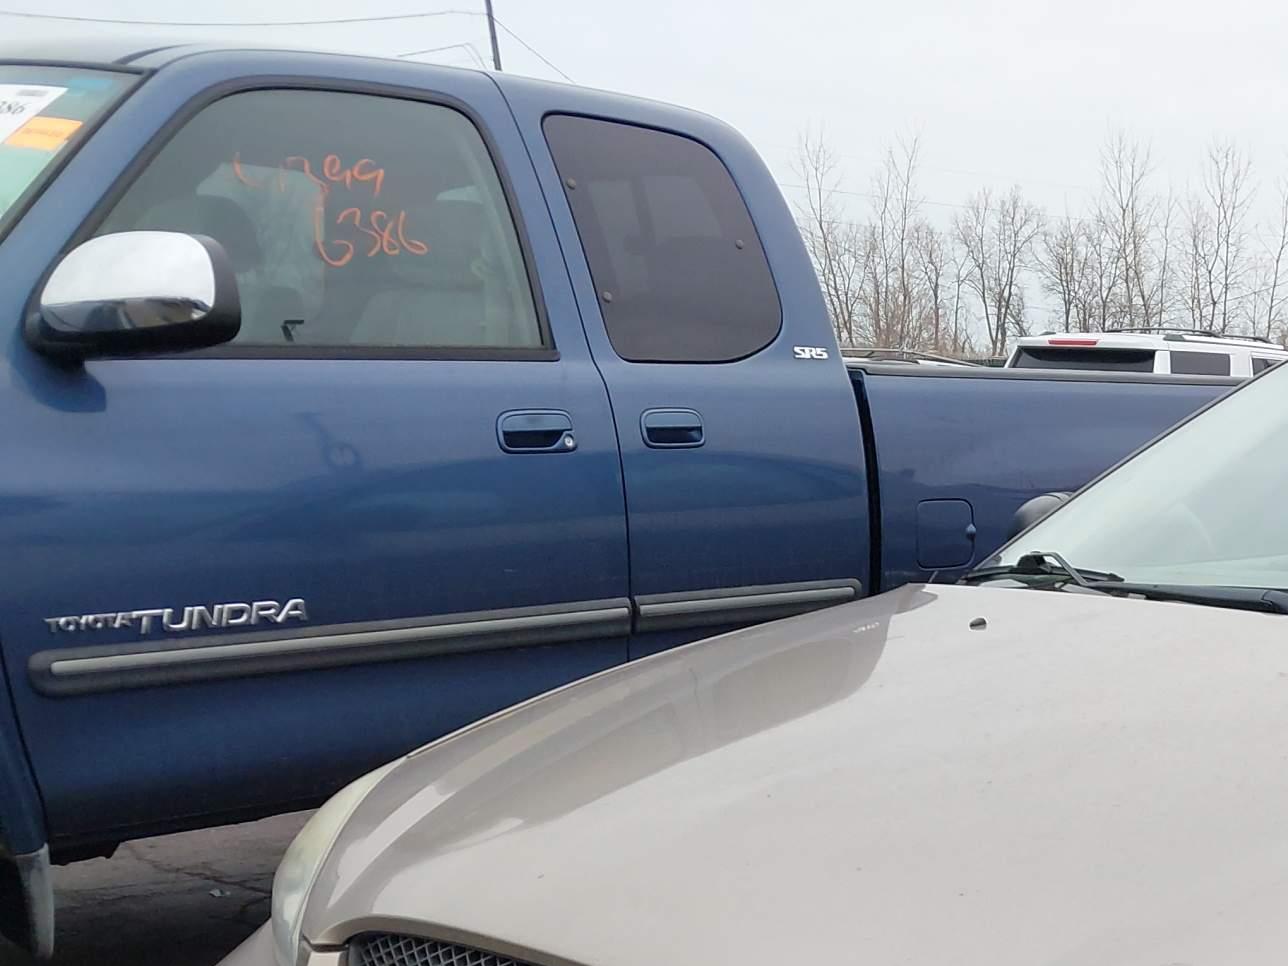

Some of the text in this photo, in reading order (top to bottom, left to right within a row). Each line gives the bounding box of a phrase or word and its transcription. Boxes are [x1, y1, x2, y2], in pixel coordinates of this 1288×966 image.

[314, 203, 429, 268] 6386
[793, 345, 829, 360] SR5
[44, 597, 309, 635] TOYOTA TUNDRA
